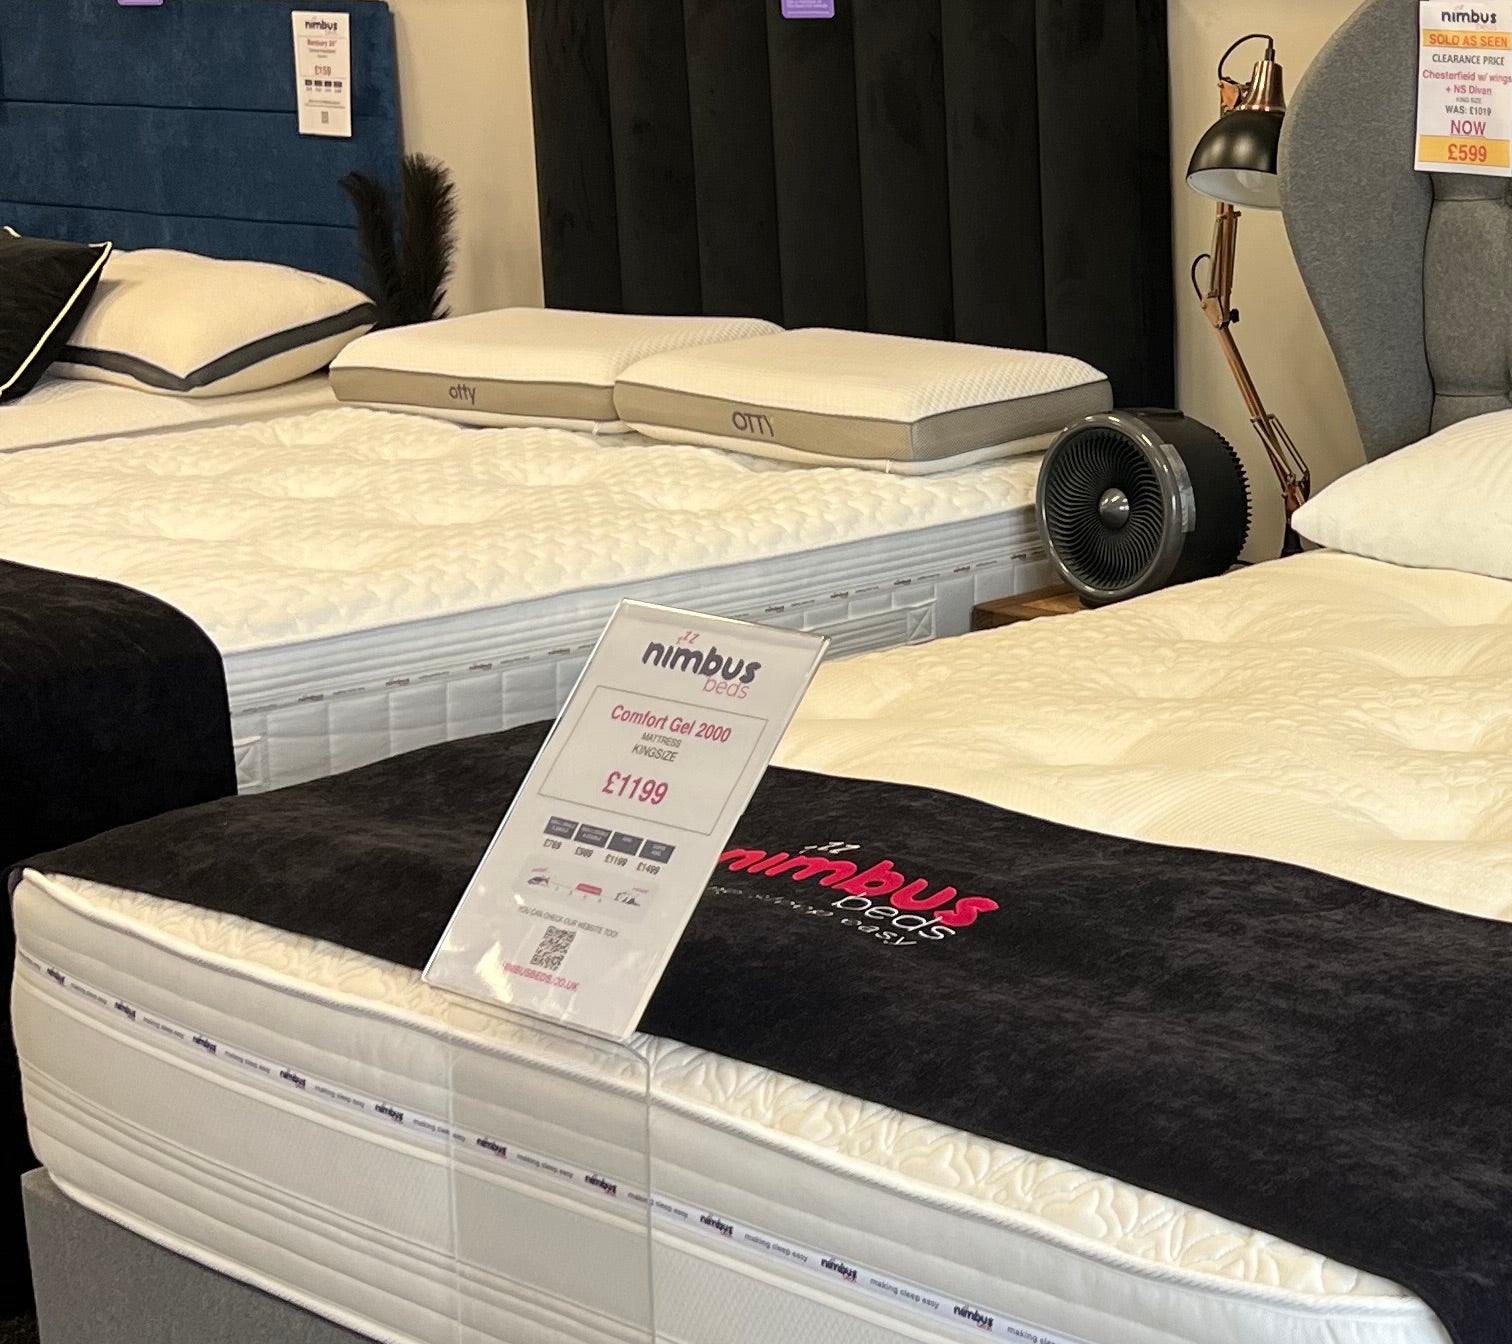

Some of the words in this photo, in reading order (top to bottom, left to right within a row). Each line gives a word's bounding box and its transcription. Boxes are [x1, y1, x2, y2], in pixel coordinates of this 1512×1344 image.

[305, 19, 337, 31] nimbus
[1441, 9, 1497, 24] nimbus
[1429, 33, 1459, 45] SOLD
[1462, 36, 1477, 46] AS
[1480, 37, 1508, 48] SEEN
[1432, 54, 1481, 65] CLEARANCE
[1483, 56, 1505, 66] PRICE
[1422, 69, 1476, 81] Chesterfield
[1489, 74, 1512, 85] wings
[1454, 85, 1466, 93] NS
[1469, 85, 1492, 95] Divan
[1445, 105, 1467, 114] WAS:
[1451, 119, 1486, 135] NOW
[1448, 143, 1487, 162] £599
[642, 641, 762, 684] nimbus
[703, 676, 749, 699] beds
[611, 705, 668, 730] Comfort
[669, 717, 696, 735] Gel
[695, 723, 732, 743] 2000
[641, 732, 682, 748] MATTRESS
[632, 744, 679, 763] KINGSIZE
[602, 771, 669, 805] £1199
[604, 854, 628, 866] £1199
[637, 862, 660, 875] £1499
[718, 848, 999, 926] nimbus
[831, 892, 956, 940] beds
[840, 918, 917, 945] easy
[745, 1233, 770, 1249] making
[772, 1243, 790, 1256] sleep
[792, 1250, 808, 1262] easy
[821, 1258, 857, 1281] nimbus
[870, 1278, 898, 1295] making
[900, 1289, 921, 1303] sleep
[922, 1297, 939, 1309] easy
[954, 1305, 994, 1327] nimbus
[1007, 1325, 1038, 1344] making
